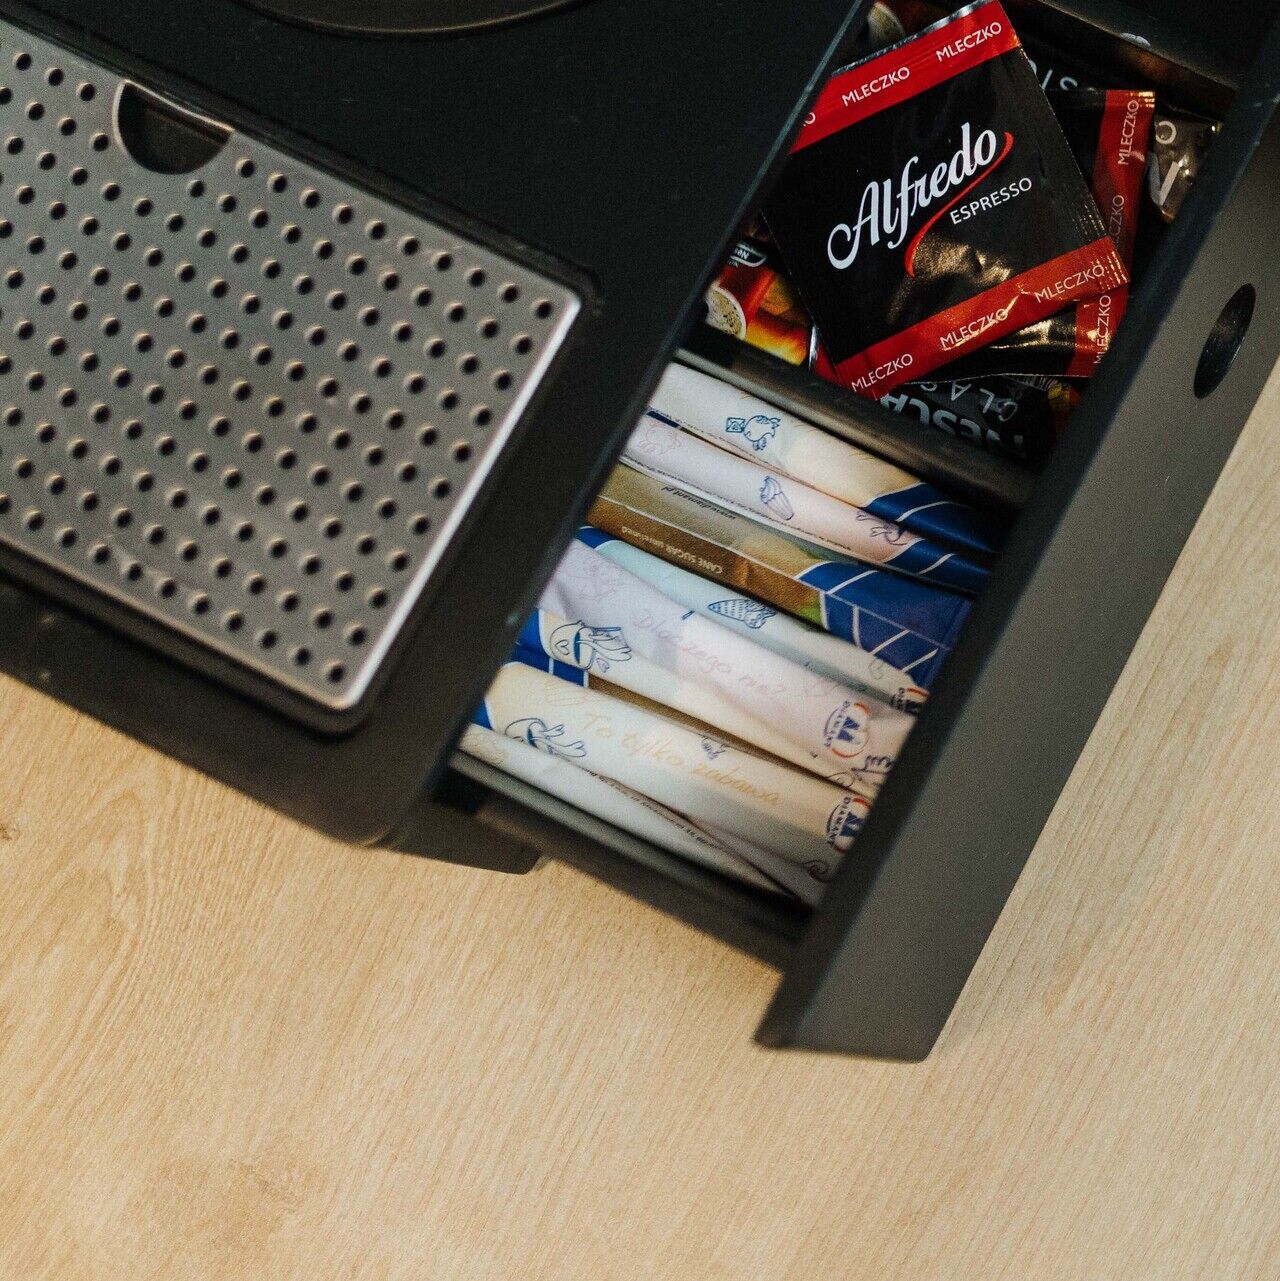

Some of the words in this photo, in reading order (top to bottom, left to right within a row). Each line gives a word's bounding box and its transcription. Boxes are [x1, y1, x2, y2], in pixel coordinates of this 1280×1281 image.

[841, 66, 911, 108] MLECZKO
[934, 21, 1003, 63] MLECZKO
[1117, 99, 1140, 166] MLECZKO
[827, 122, 997, 270] Alfredo
[949, 177, 1033, 226] ESPRESSO
[851, 353, 914, 394] MLECZKO
[939, 308, 1009, 350] MLECZKO
[1034, 262, 1106, 304] MLECZKO
